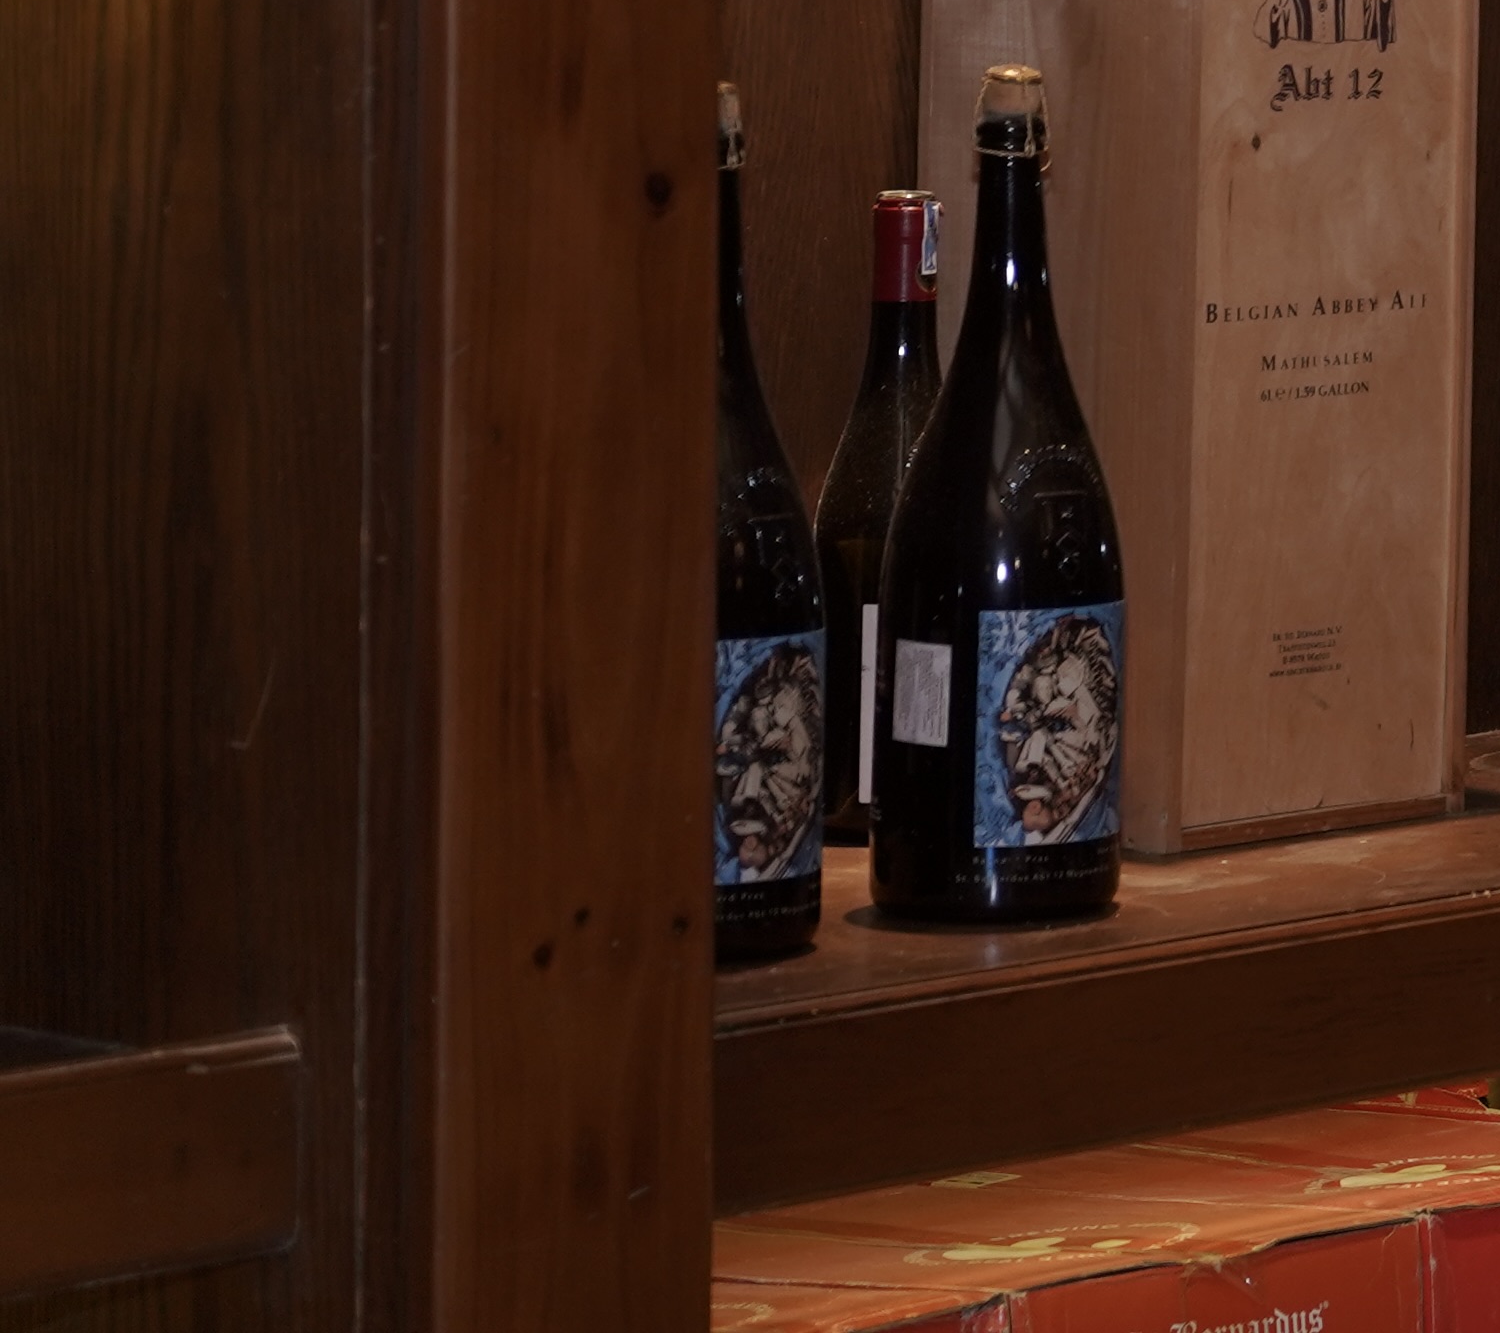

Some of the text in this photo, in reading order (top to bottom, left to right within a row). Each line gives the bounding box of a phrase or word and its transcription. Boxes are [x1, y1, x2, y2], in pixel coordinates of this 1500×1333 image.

[1270, 64, 1384, 112] Abt 12
[1206, 303, 1299, 324] BELGIAN
[1312, 296, 1379, 316] ABBEY
[1318, 381, 1370, 399] GALLON
